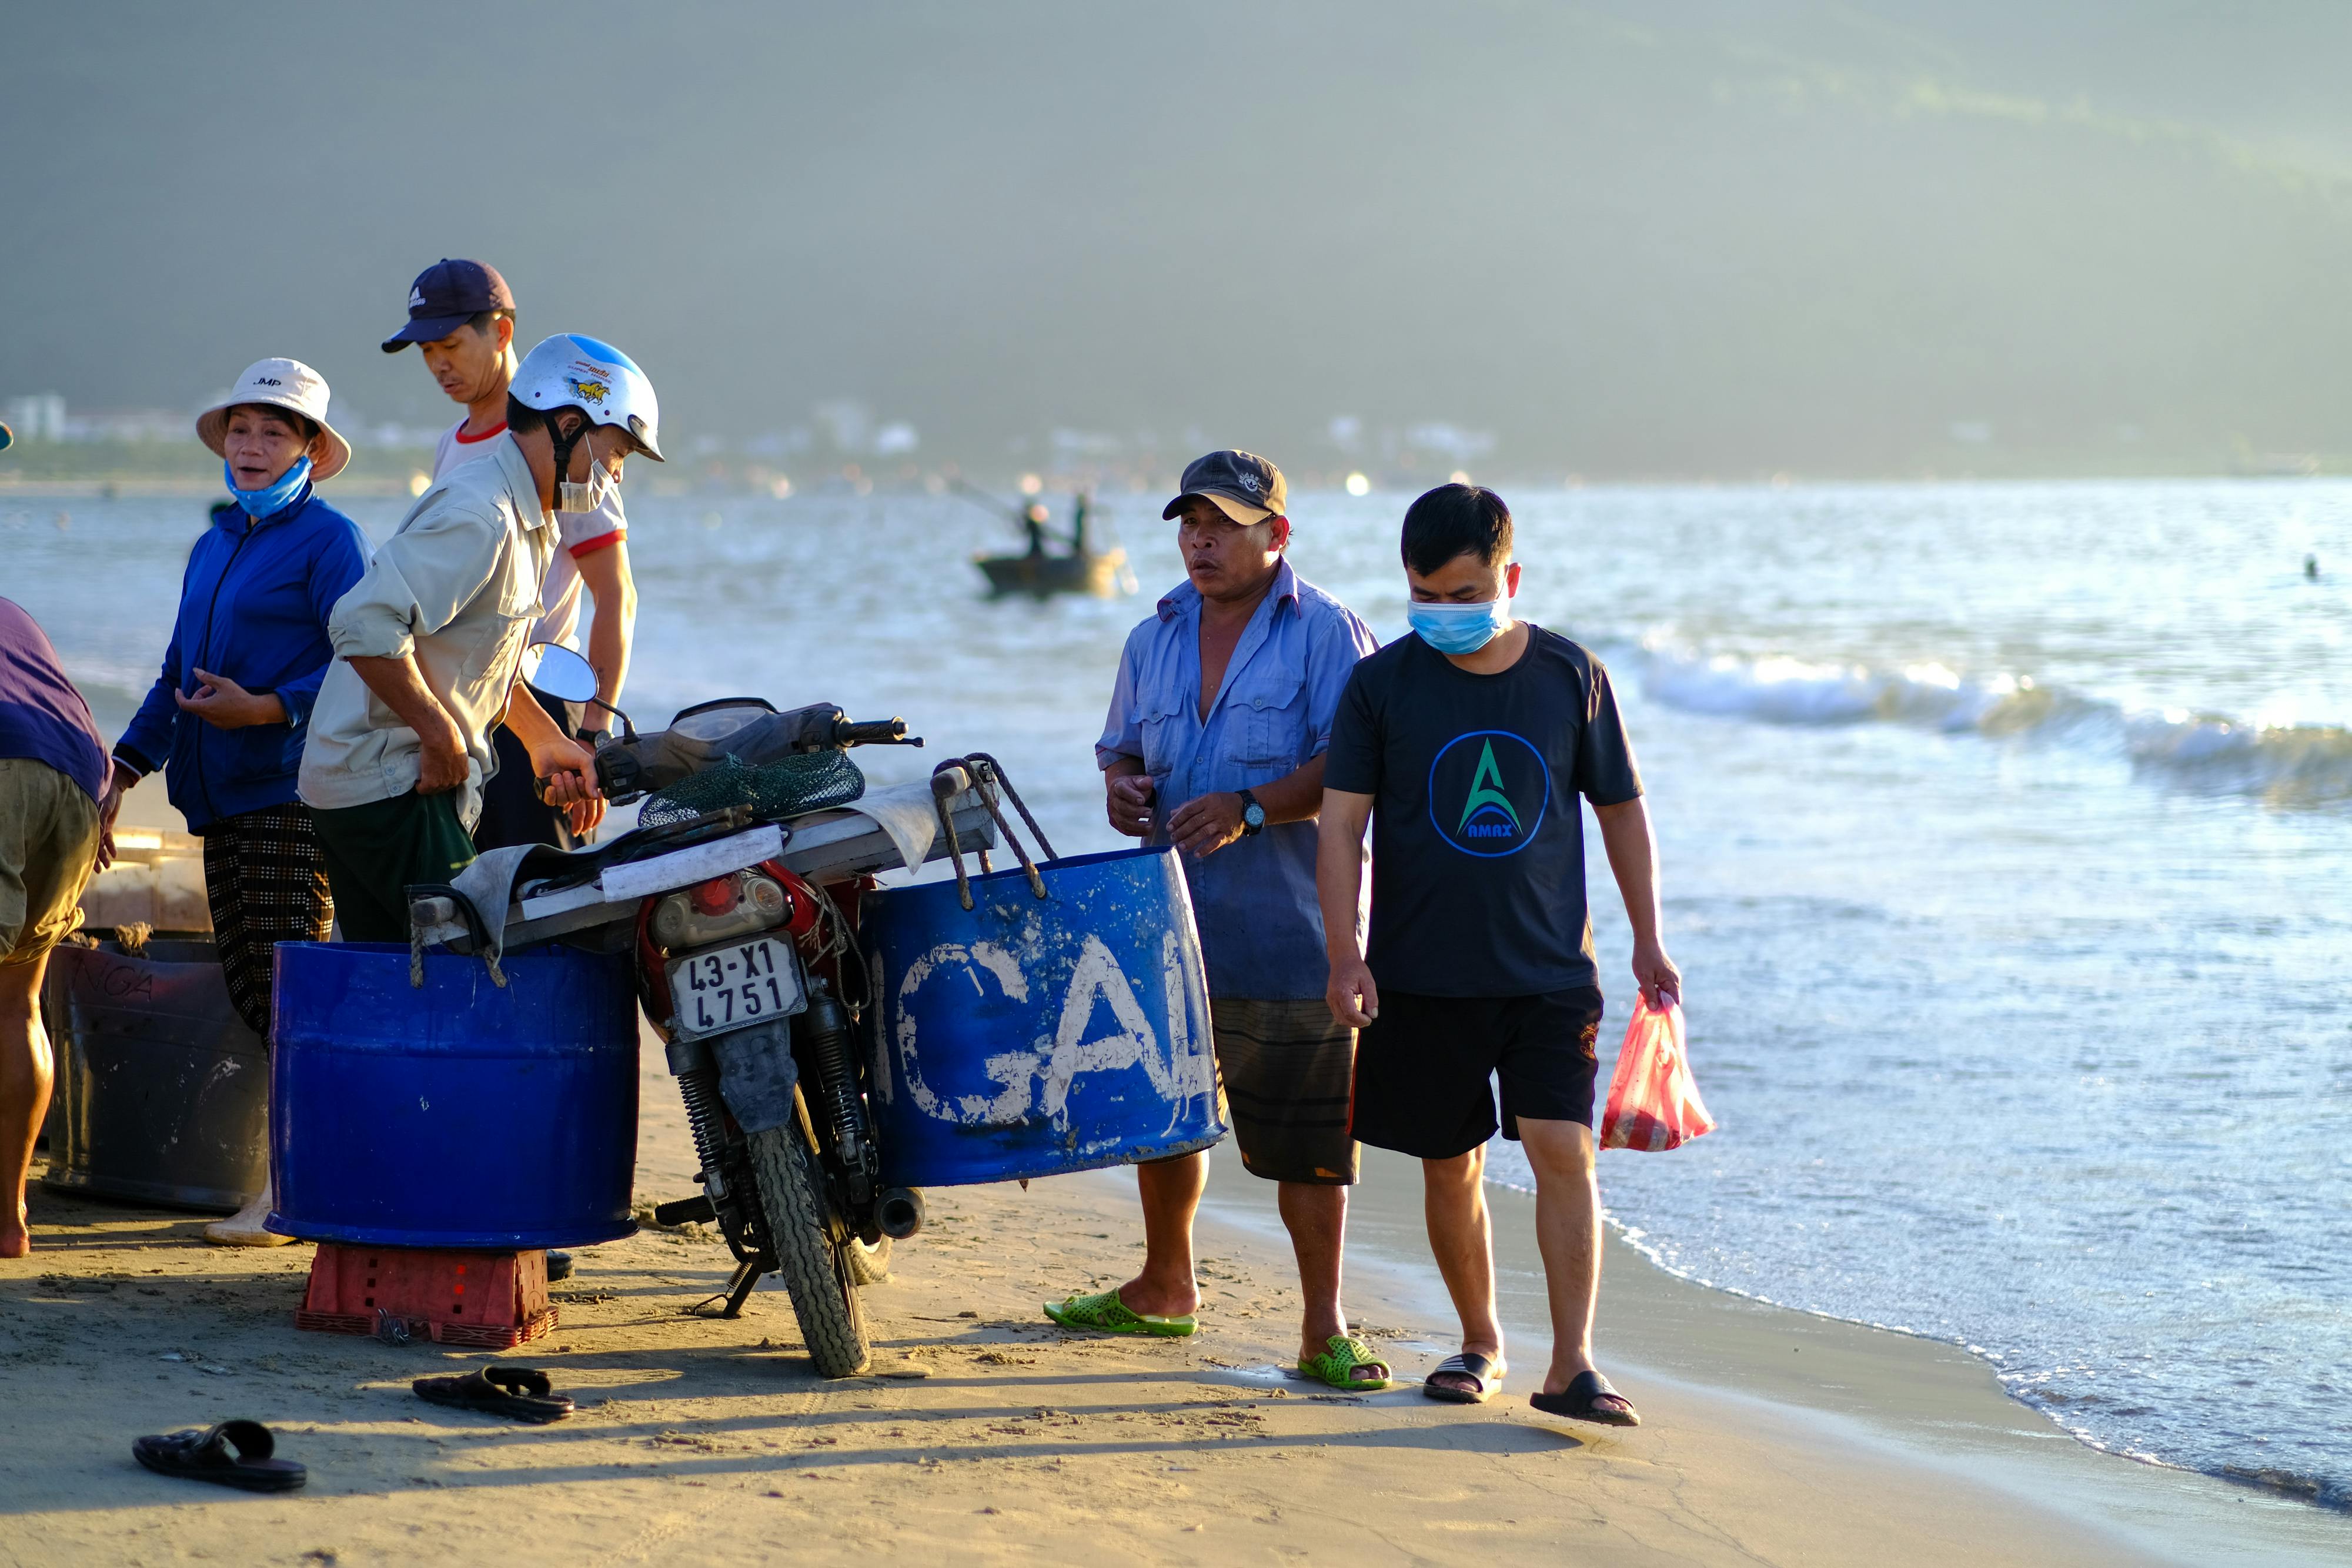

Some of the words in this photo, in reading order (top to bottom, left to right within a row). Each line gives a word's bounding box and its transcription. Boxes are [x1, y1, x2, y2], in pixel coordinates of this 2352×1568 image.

[253, 377, 281, 386] JMP
[1239, 472, 1259, 484] adidas
[1468, 824, 1511, 837] AMAX
[690, 942, 773, 991] 43-X1
[698, 978, 781, 1027] 4751
